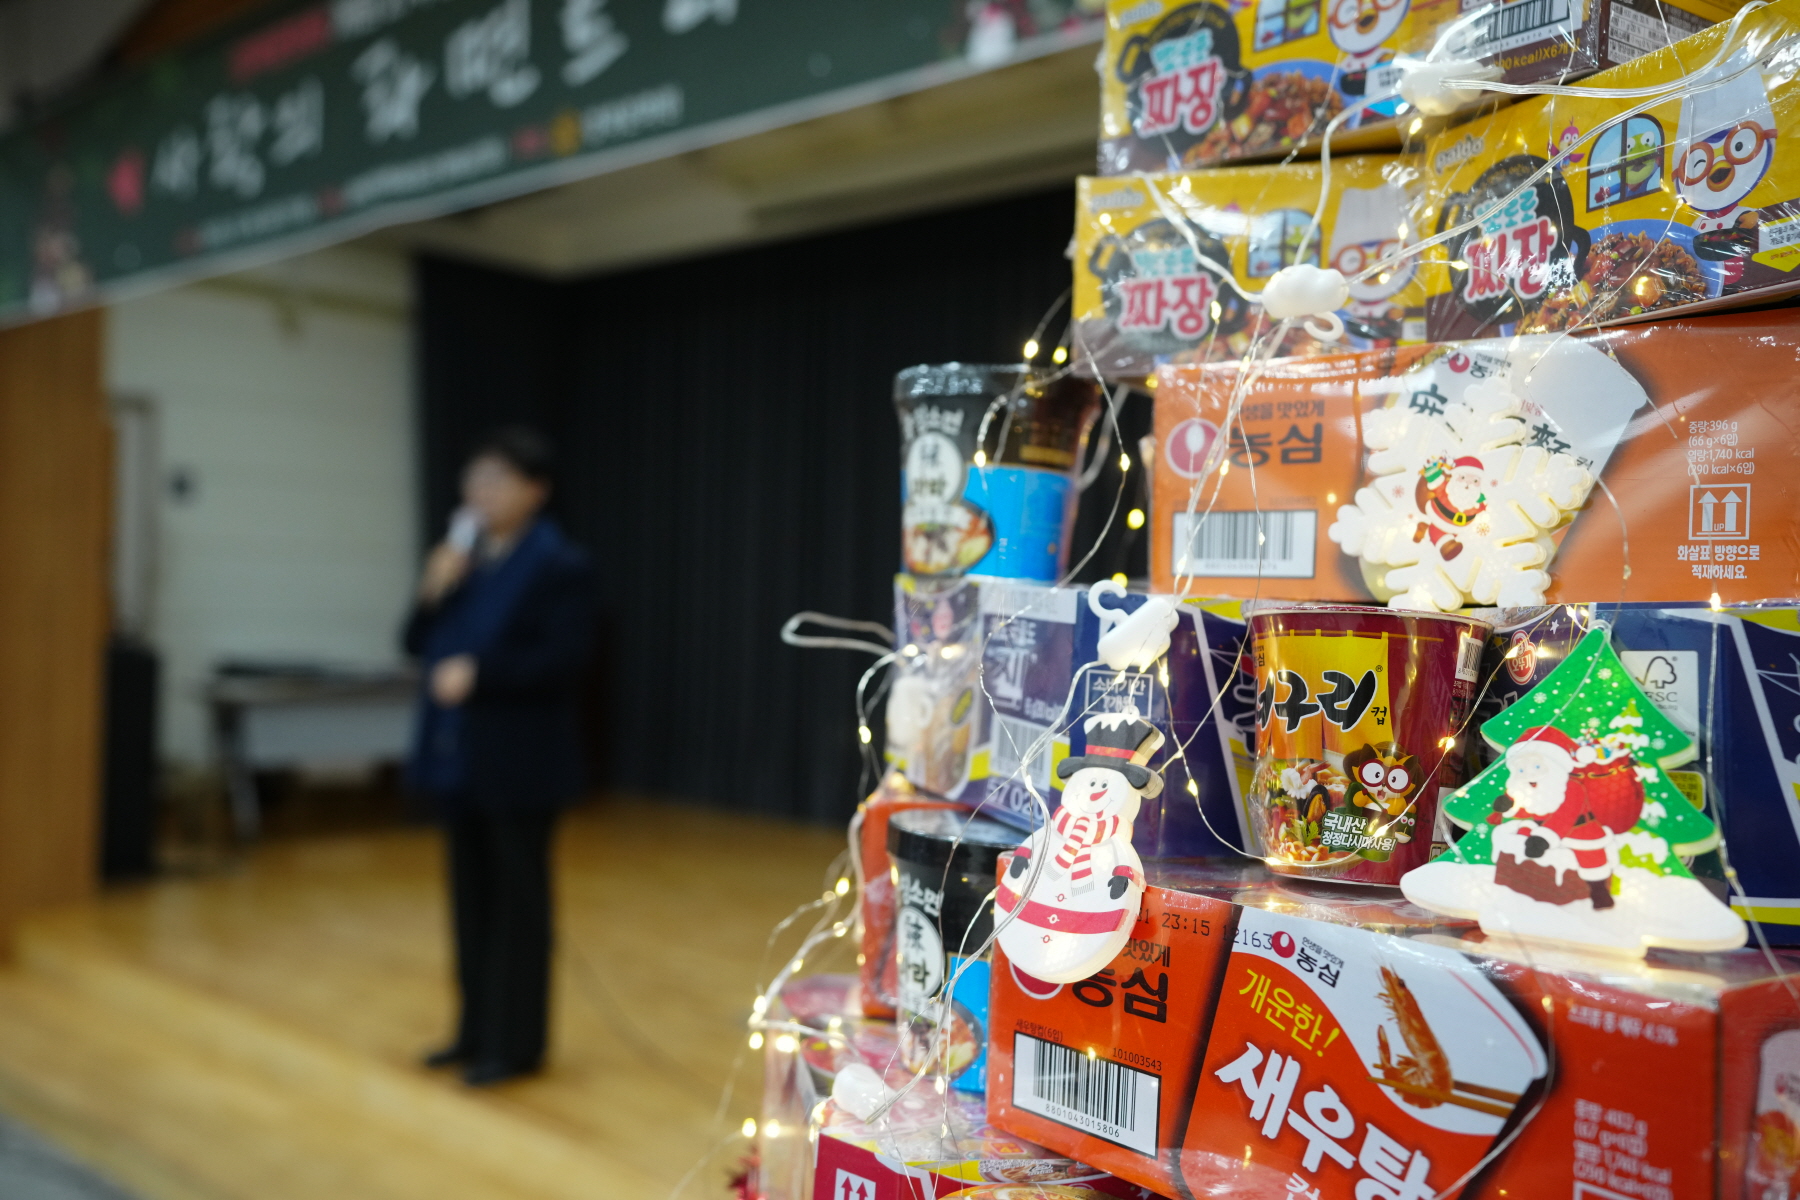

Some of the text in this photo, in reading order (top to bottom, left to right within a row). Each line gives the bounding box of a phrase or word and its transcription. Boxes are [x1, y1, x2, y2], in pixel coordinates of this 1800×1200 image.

[1140, 59, 1221, 134] 짜장
[1466, 221, 1556, 300] 짜장
[1121, 275, 1214, 336] 짜장
[1230, 422, 1324, 468] 농심
[1735, 448, 1755, 459] kcal
[1713, 523, 1725, 532] UP
[1677, 545, 1760, 561] 화살표 방향으로
[1691, 564, 1748, 579] 적재하세요.
[1371, 706, 1387, 725] 컵
[1324, 812, 1366, 834] 국내산
[1161, 912, 1211, 937] 23:15
[1296, 946, 1340, 988] 농심
[1238, 968, 1341, 1057] 개운한!
[1112, 1047, 1162, 1071] 101003543
[1045, 1102, 1120, 1138] 8801043015806
[1214, 1041, 1438, 1200] 새우탕
